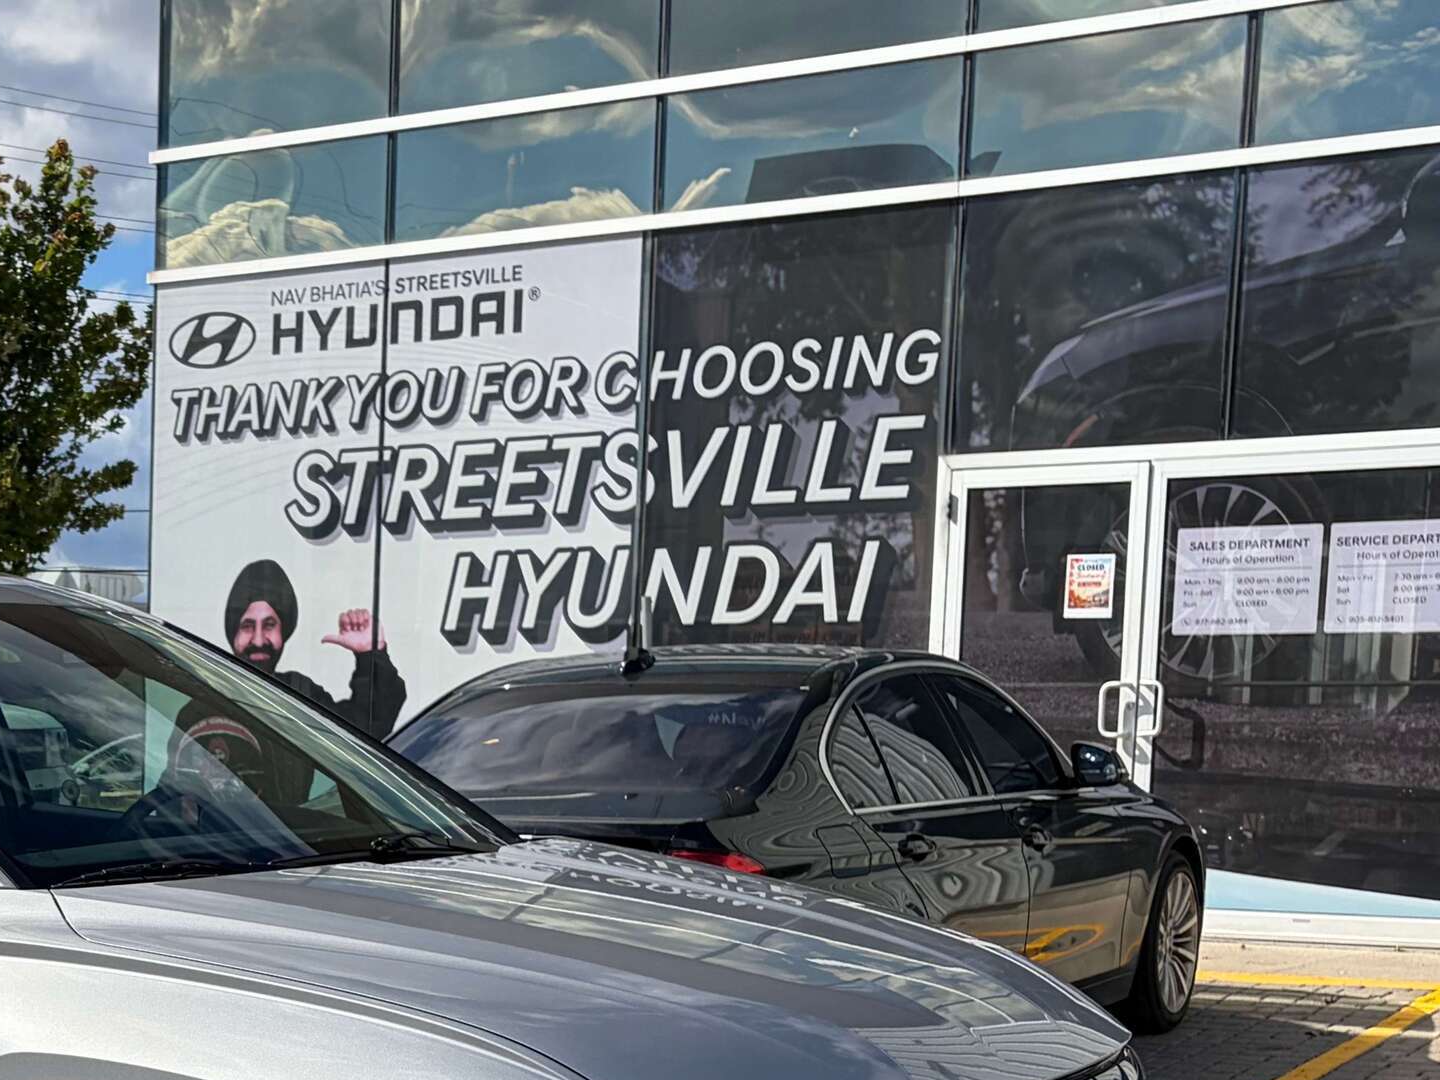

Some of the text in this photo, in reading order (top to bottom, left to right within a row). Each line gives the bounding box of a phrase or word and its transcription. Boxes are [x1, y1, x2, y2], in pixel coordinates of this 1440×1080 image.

[271, 265, 523, 306] NAV BHATIA'S STREETSVILLE
[172, 329, 942, 443] THANK YOU FOR CHOOSING
[286, 414, 930, 536] STREETSVILLE
[1189, 537, 1311, 552] SALES DEPARTMENT
[1336, 534, 1389, 547] SERVICE
[1202, 554, 1295, 566] Hours of Operation
[1356, 550, 1387, 561] Hours
[1389, 550, 1401, 560] of
[442, 539, 888, 644] HYUNDAI
